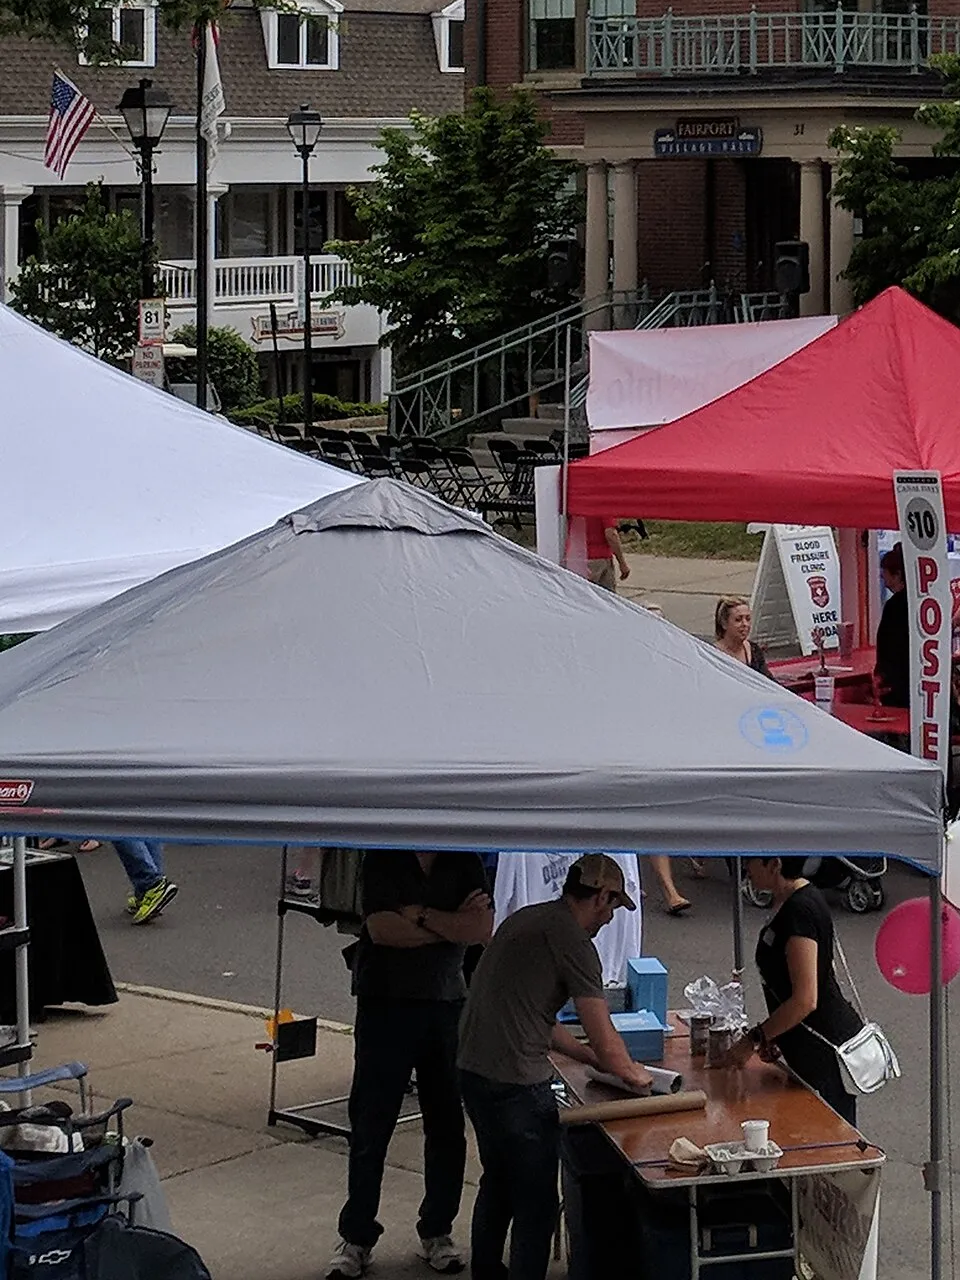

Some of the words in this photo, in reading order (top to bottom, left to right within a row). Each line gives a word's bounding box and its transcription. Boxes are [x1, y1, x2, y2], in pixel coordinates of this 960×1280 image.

[678, 123, 733, 136] FAIRPORT
[793, 124, 805, 136] 31
[144, 311, 159, 324] 81
[907, 510, 935, 538] $10
[795, 540, 820, 551] BLOOD
[790, 550, 830, 564] PRESSURE
[812, 610, 838, 624] HERE
